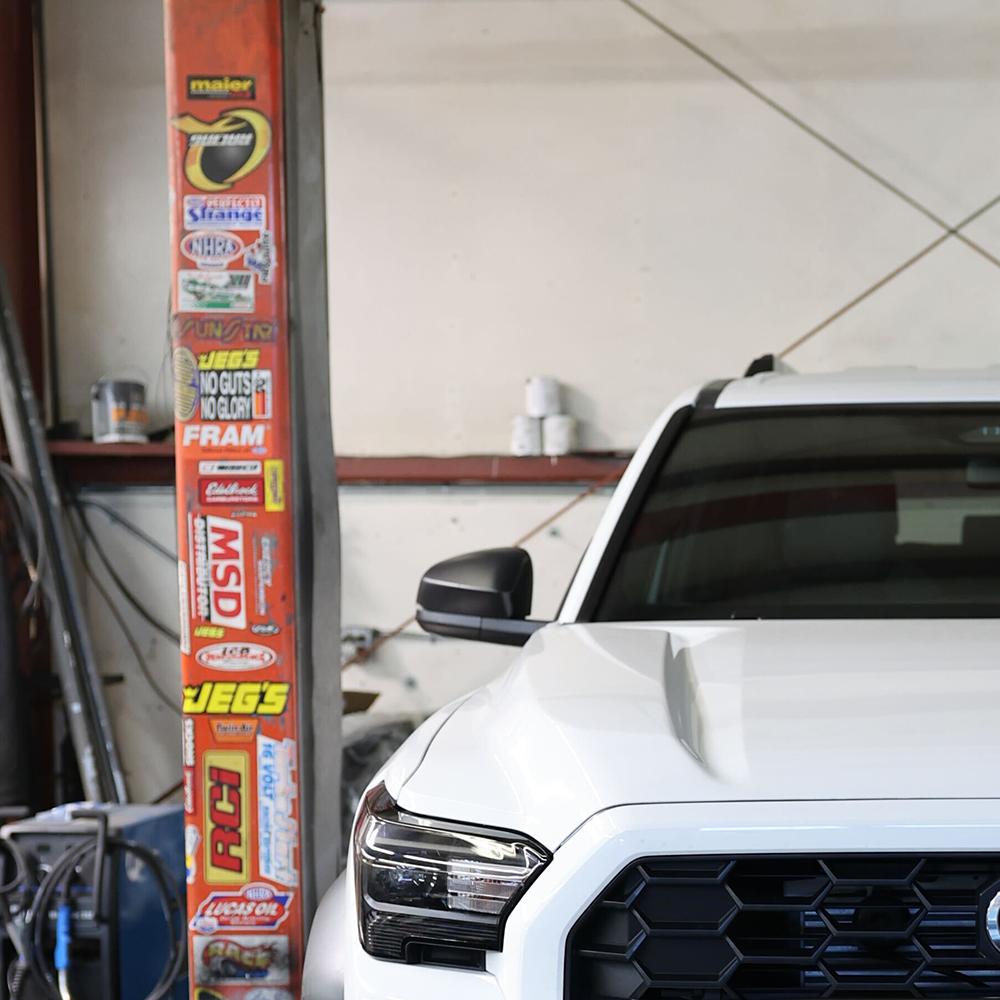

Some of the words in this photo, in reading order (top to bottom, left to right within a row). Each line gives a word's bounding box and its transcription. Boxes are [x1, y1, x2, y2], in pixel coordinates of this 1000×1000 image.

[190, 76, 253, 91] maier
[188, 207, 262, 221] Strange
[189, 237, 237, 256] NHRA
[200, 370, 219, 394] NO
[219, 370, 252, 394] GUTS
[201, 396, 217, 419] NO
[217, 396, 251, 419] GLORY
[183, 424, 265, 447] FRAM
[211, 526, 242, 618] MSD
[182, 681, 291, 714] JEG'S
[262, 743, 273, 758] 16
[262, 764, 273, 800] VOLT
[205, 901, 254, 916] LUCAS
[254, 901, 279, 916] OIL
